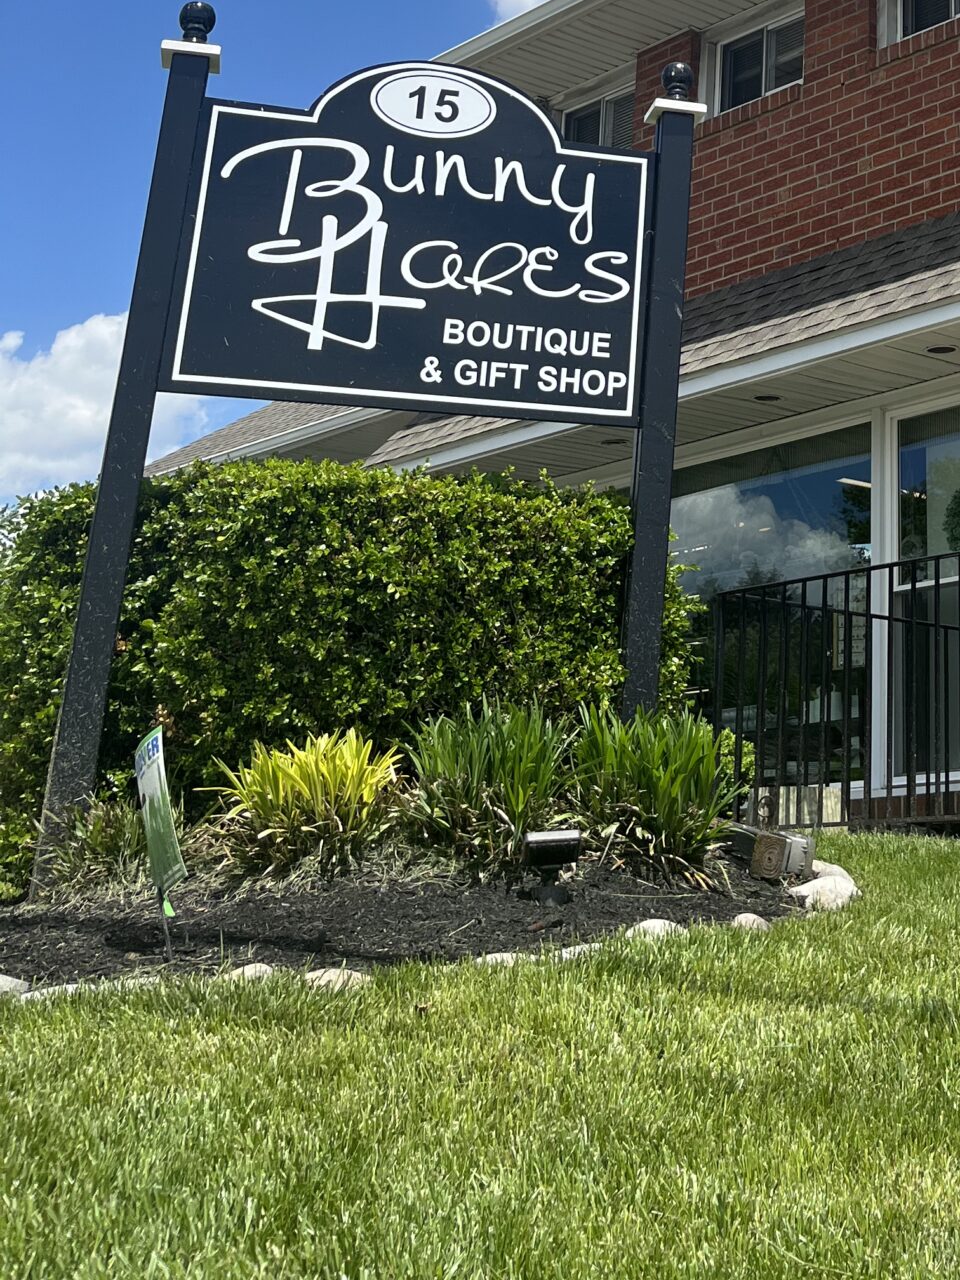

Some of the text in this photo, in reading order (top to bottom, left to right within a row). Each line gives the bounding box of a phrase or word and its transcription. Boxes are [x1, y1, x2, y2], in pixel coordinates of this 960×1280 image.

[407, 85, 460, 124] 15
[220, 136, 597, 264] Bunny
[442, 317, 612, 358] BOUTIQUE
[419, 355, 627, 397] & GIFT SHOP
